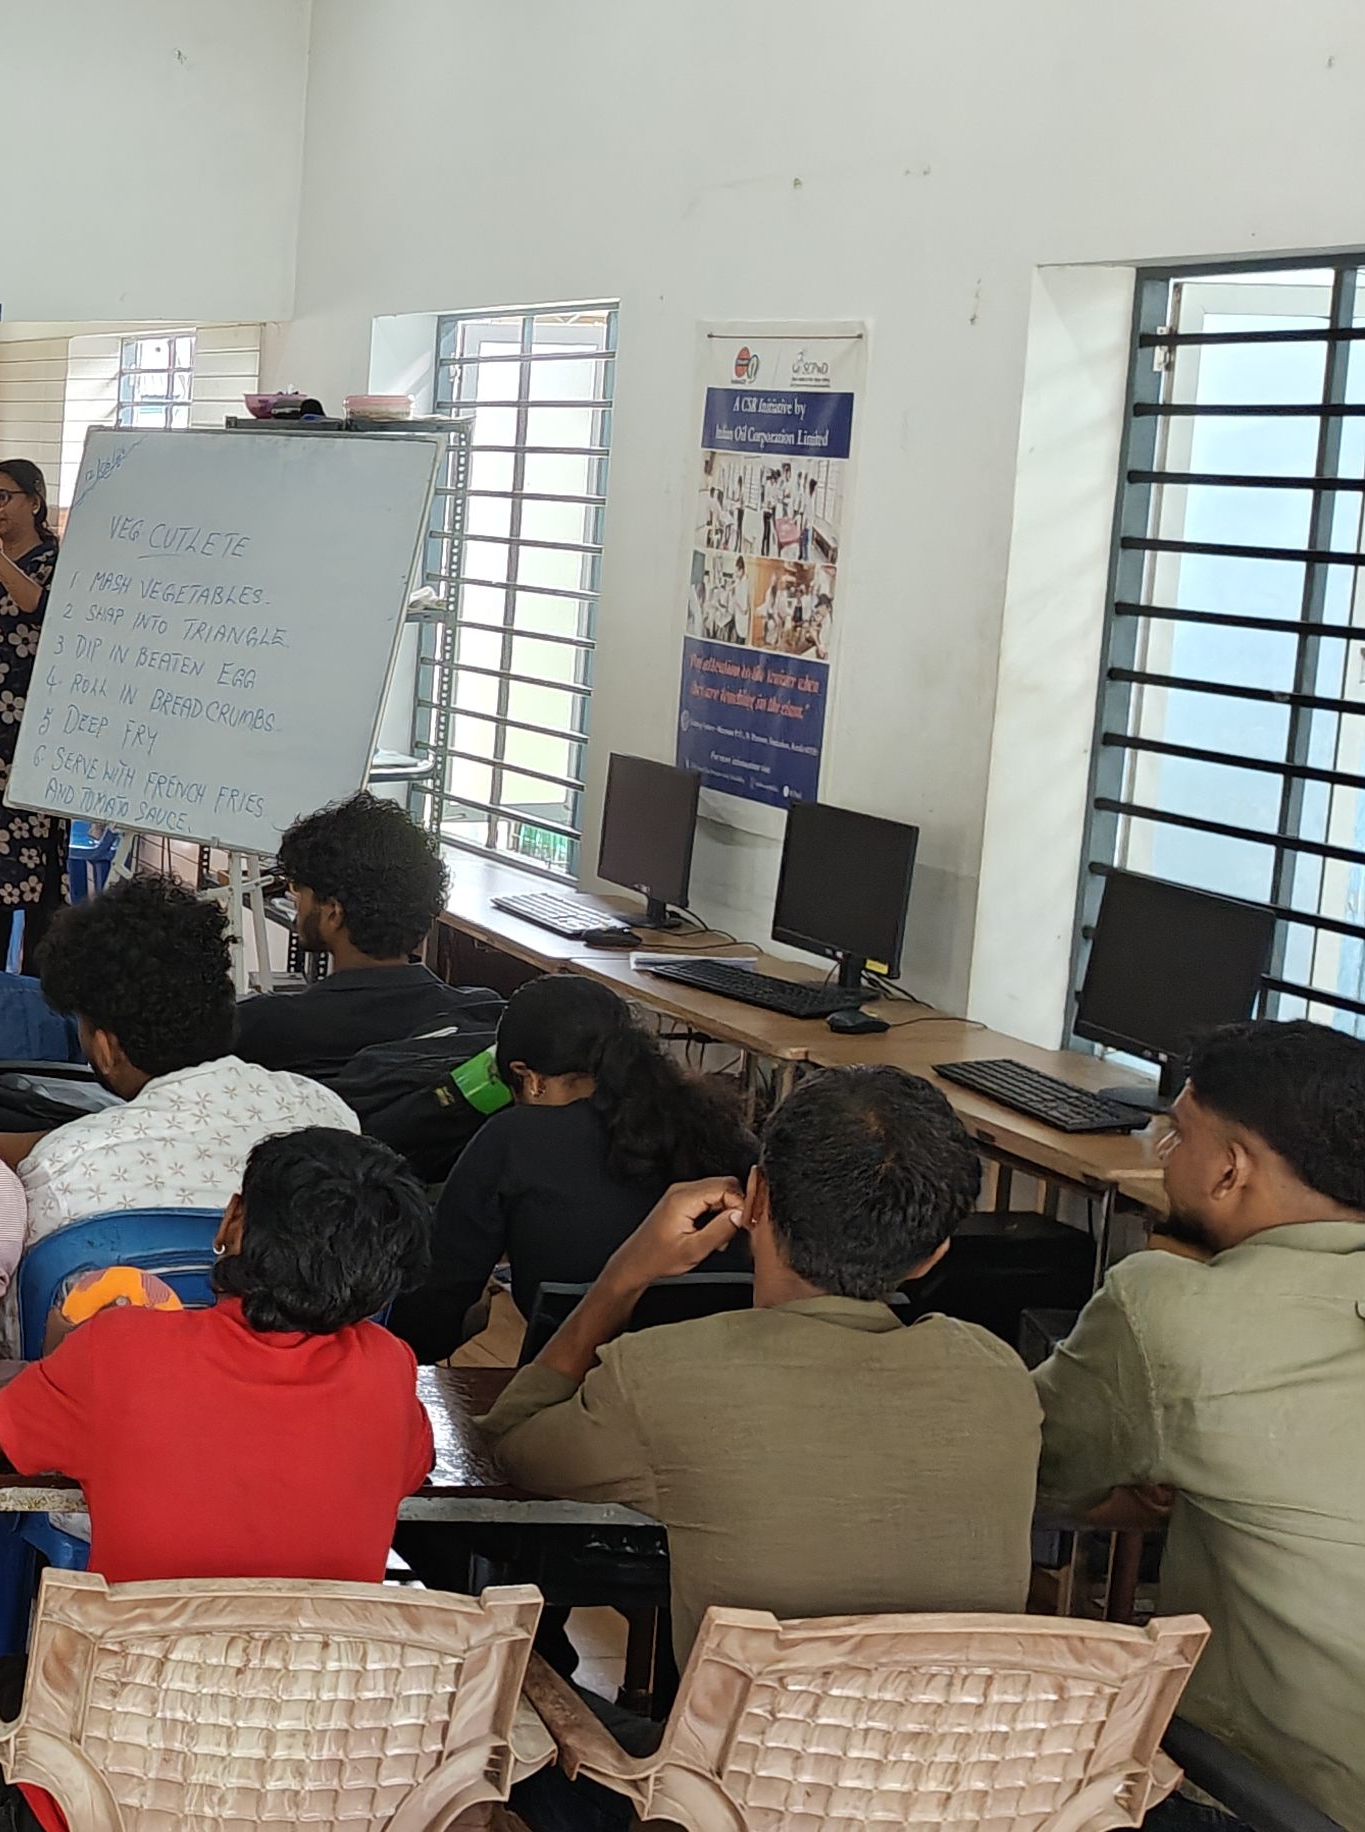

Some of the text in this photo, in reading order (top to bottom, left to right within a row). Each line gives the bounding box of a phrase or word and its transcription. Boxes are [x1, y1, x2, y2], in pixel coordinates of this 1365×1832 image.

[732, 395, 807, 421] A CSR Initiative by
[734, 424, 747, 442] Oil
[747, 426, 795, 448] Corporation
[796, 429, 830, 447] Limited
[109, 515, 251, 558] VEG CUTLETE
[89, 571, 133, 593] MASH
[62, 602, 73, 620] 2
[132, 611, 168, 635] INTO
[53, 633, 257, 689] 3 DIP IN BEATEN EGG
[70, 672, 107, 698] ROLL
[119, 683, 139, 705] IN
[63, 703, 110, 739] DEEP
[121, 719, 159, 756] FRY
[44, 777, 75, 805] AND
[51, 746, 98, 780] SERVE
[102, 759, 137, 788] WITH
[143, 770, 207, 805] FRENCH
[213, 785, 265, 818] FRIES
